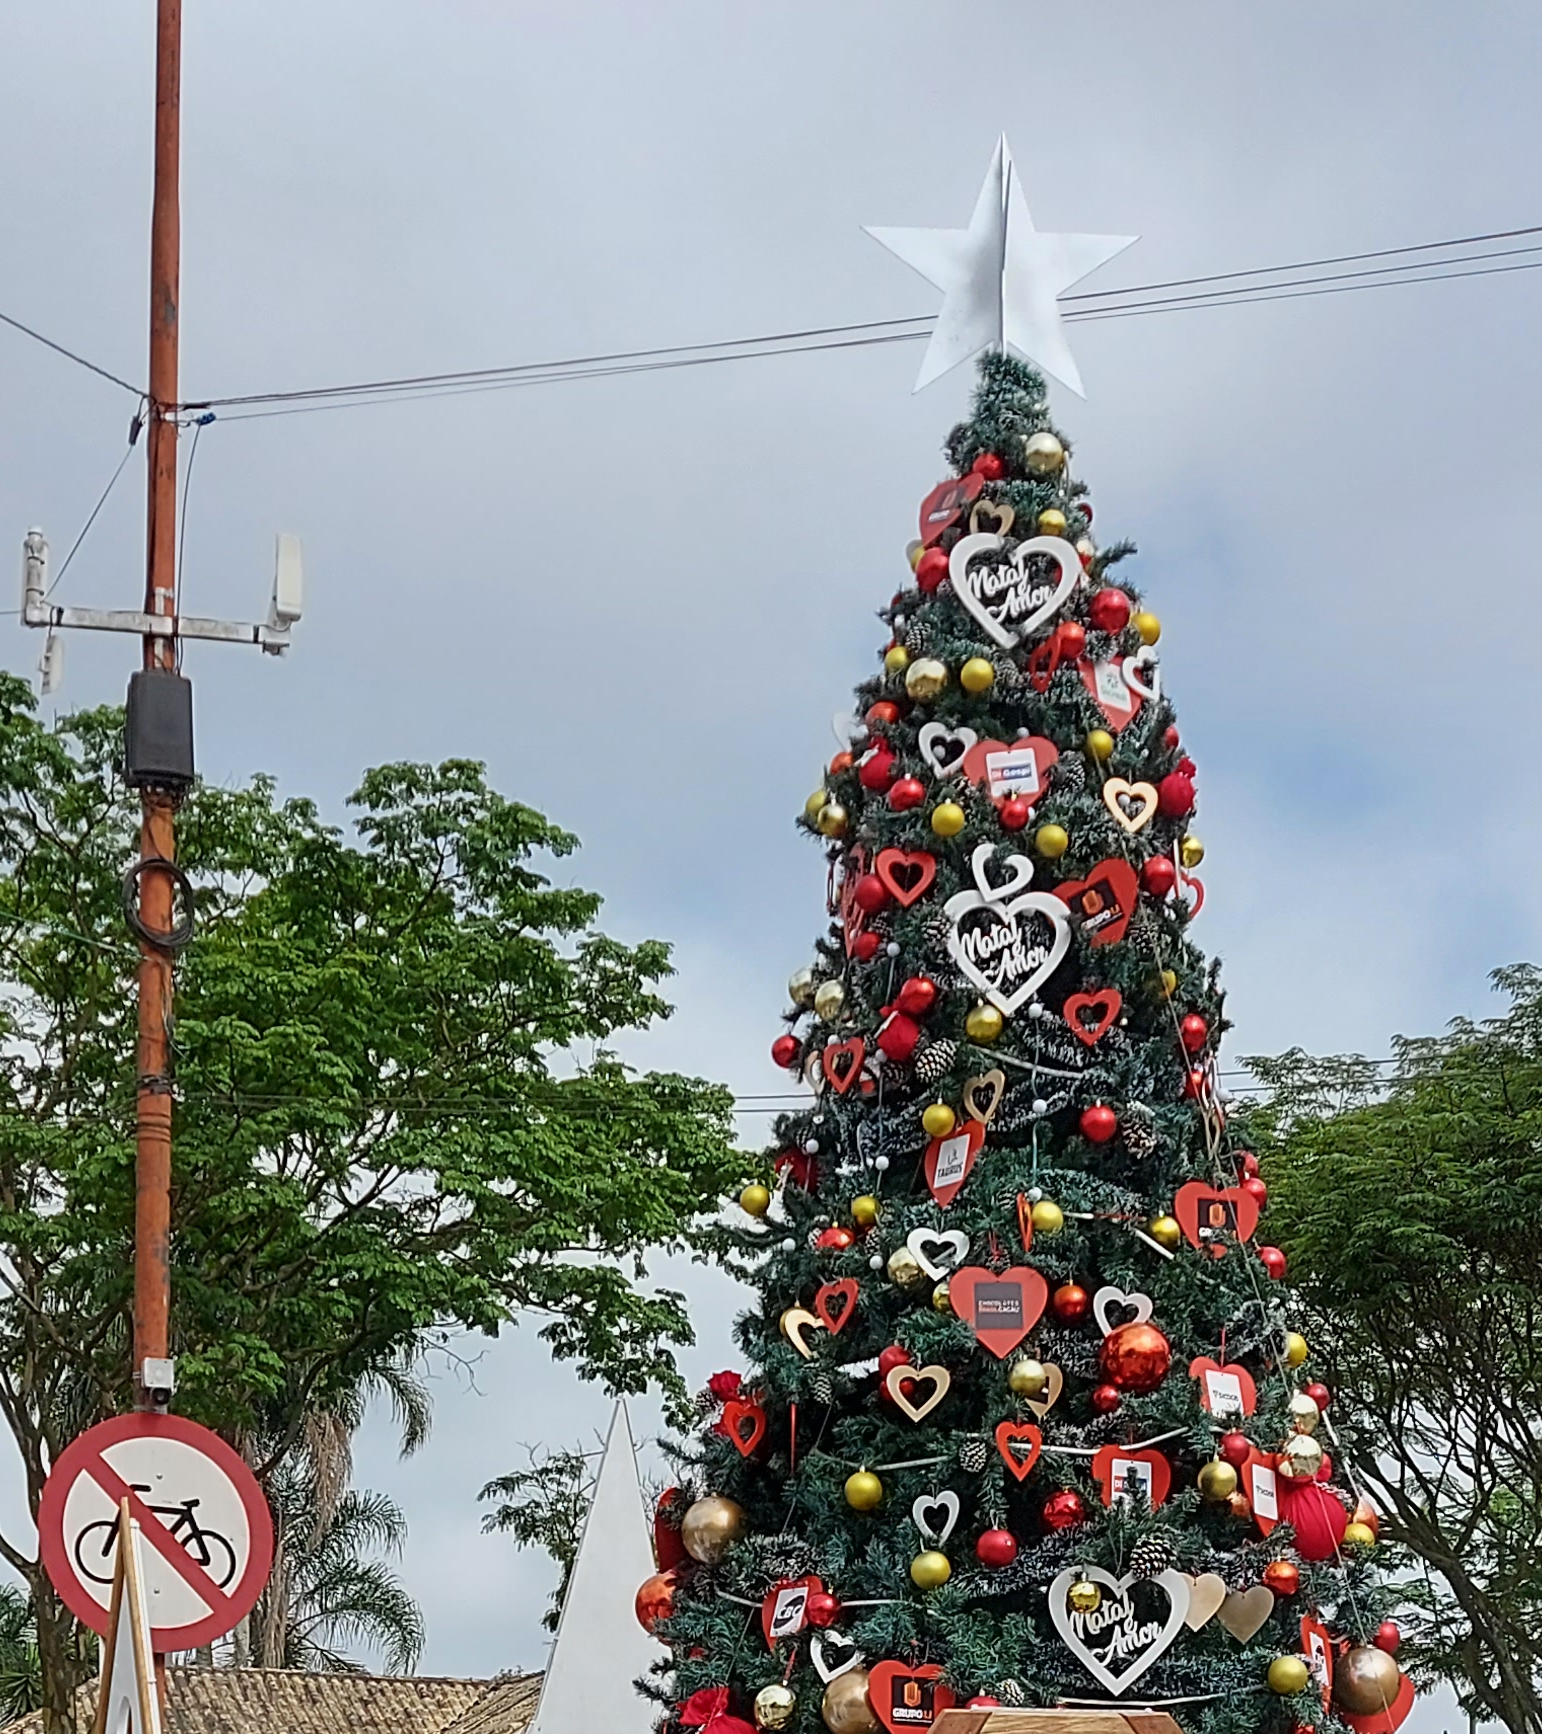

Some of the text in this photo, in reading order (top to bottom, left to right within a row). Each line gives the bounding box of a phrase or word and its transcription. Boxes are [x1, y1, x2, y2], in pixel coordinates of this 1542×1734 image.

[967, 554, 1024, 600] Natal
[986, 586, 1053, 622] Amor
[961, 915, 1017, 962] Natal
[982, 945, 1048, 989] Amor
[937, 1161, 964, 1178] TAURUS
[1091, 1621, 1163, 1667] Amor
[892, 1707, 923, 1720] GRUPO
